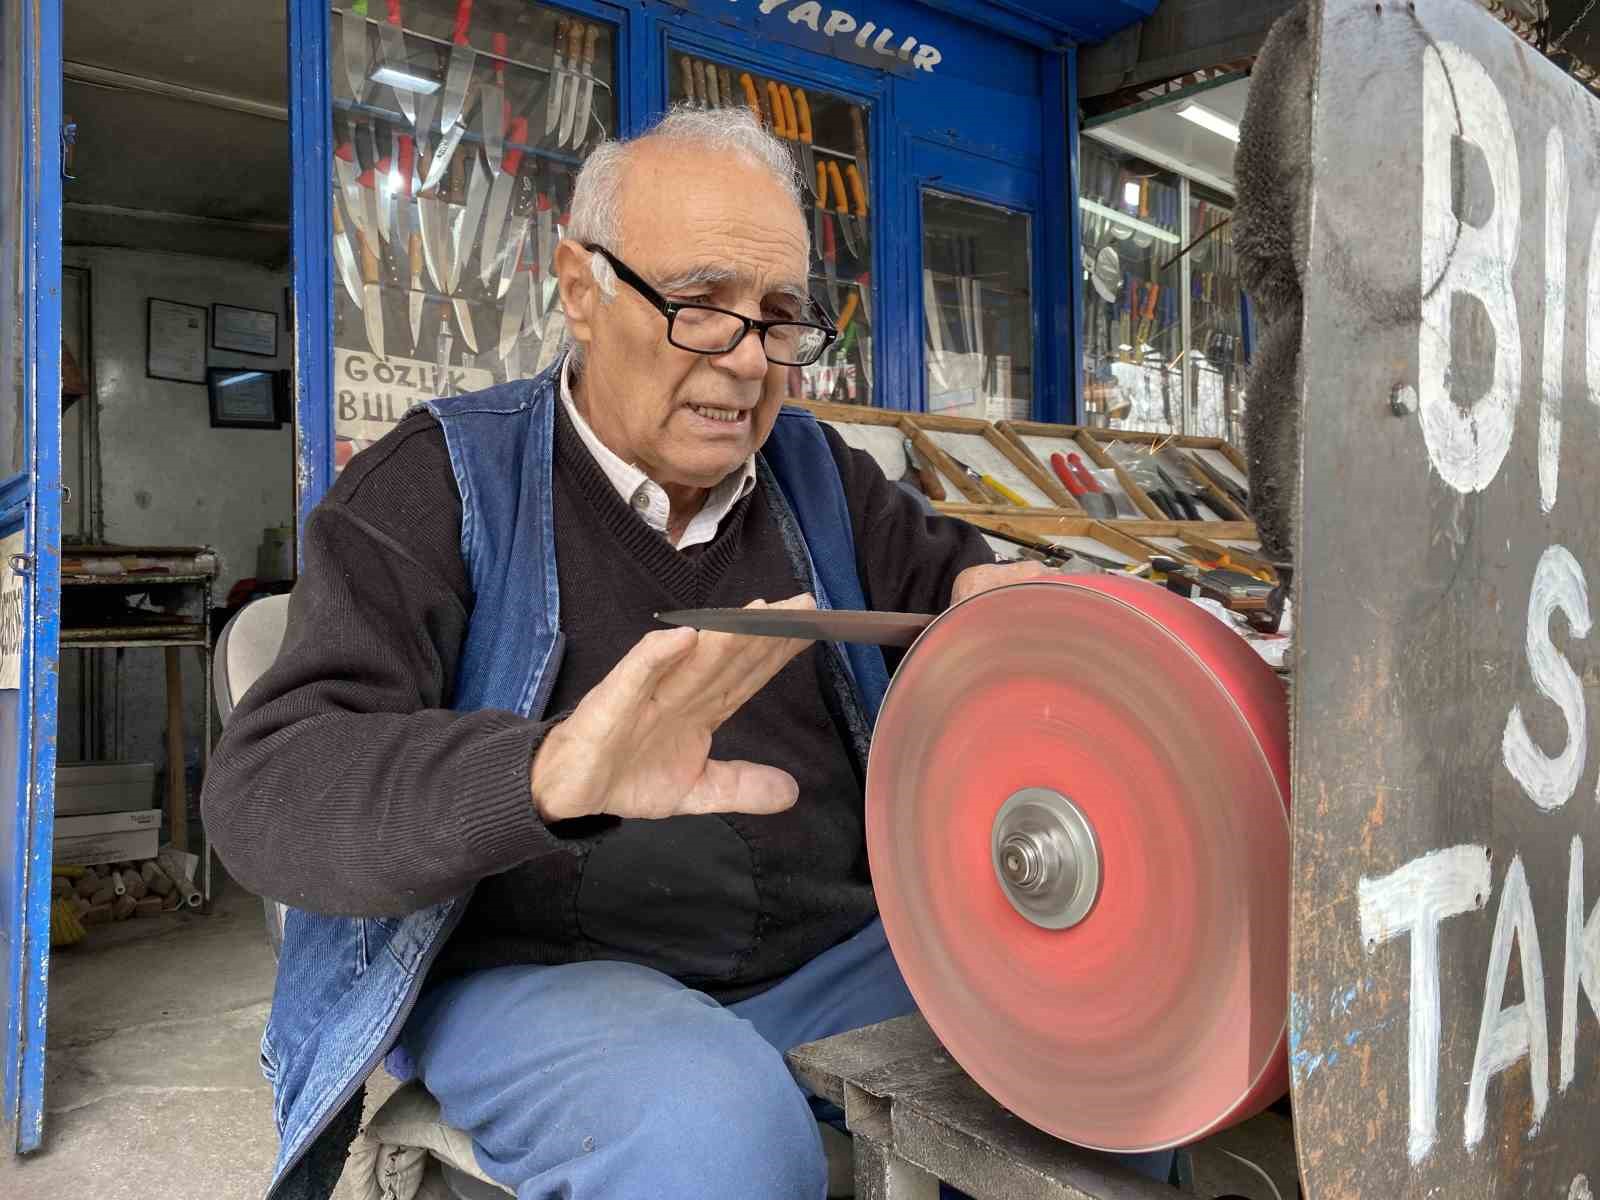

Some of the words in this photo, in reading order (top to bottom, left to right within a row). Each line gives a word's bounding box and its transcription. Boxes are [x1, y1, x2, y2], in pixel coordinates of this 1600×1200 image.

[338, 390, 413, 422] BUL
[1418, 40, 1600, 513] BI
[1503, 543, 1600, 812] S
